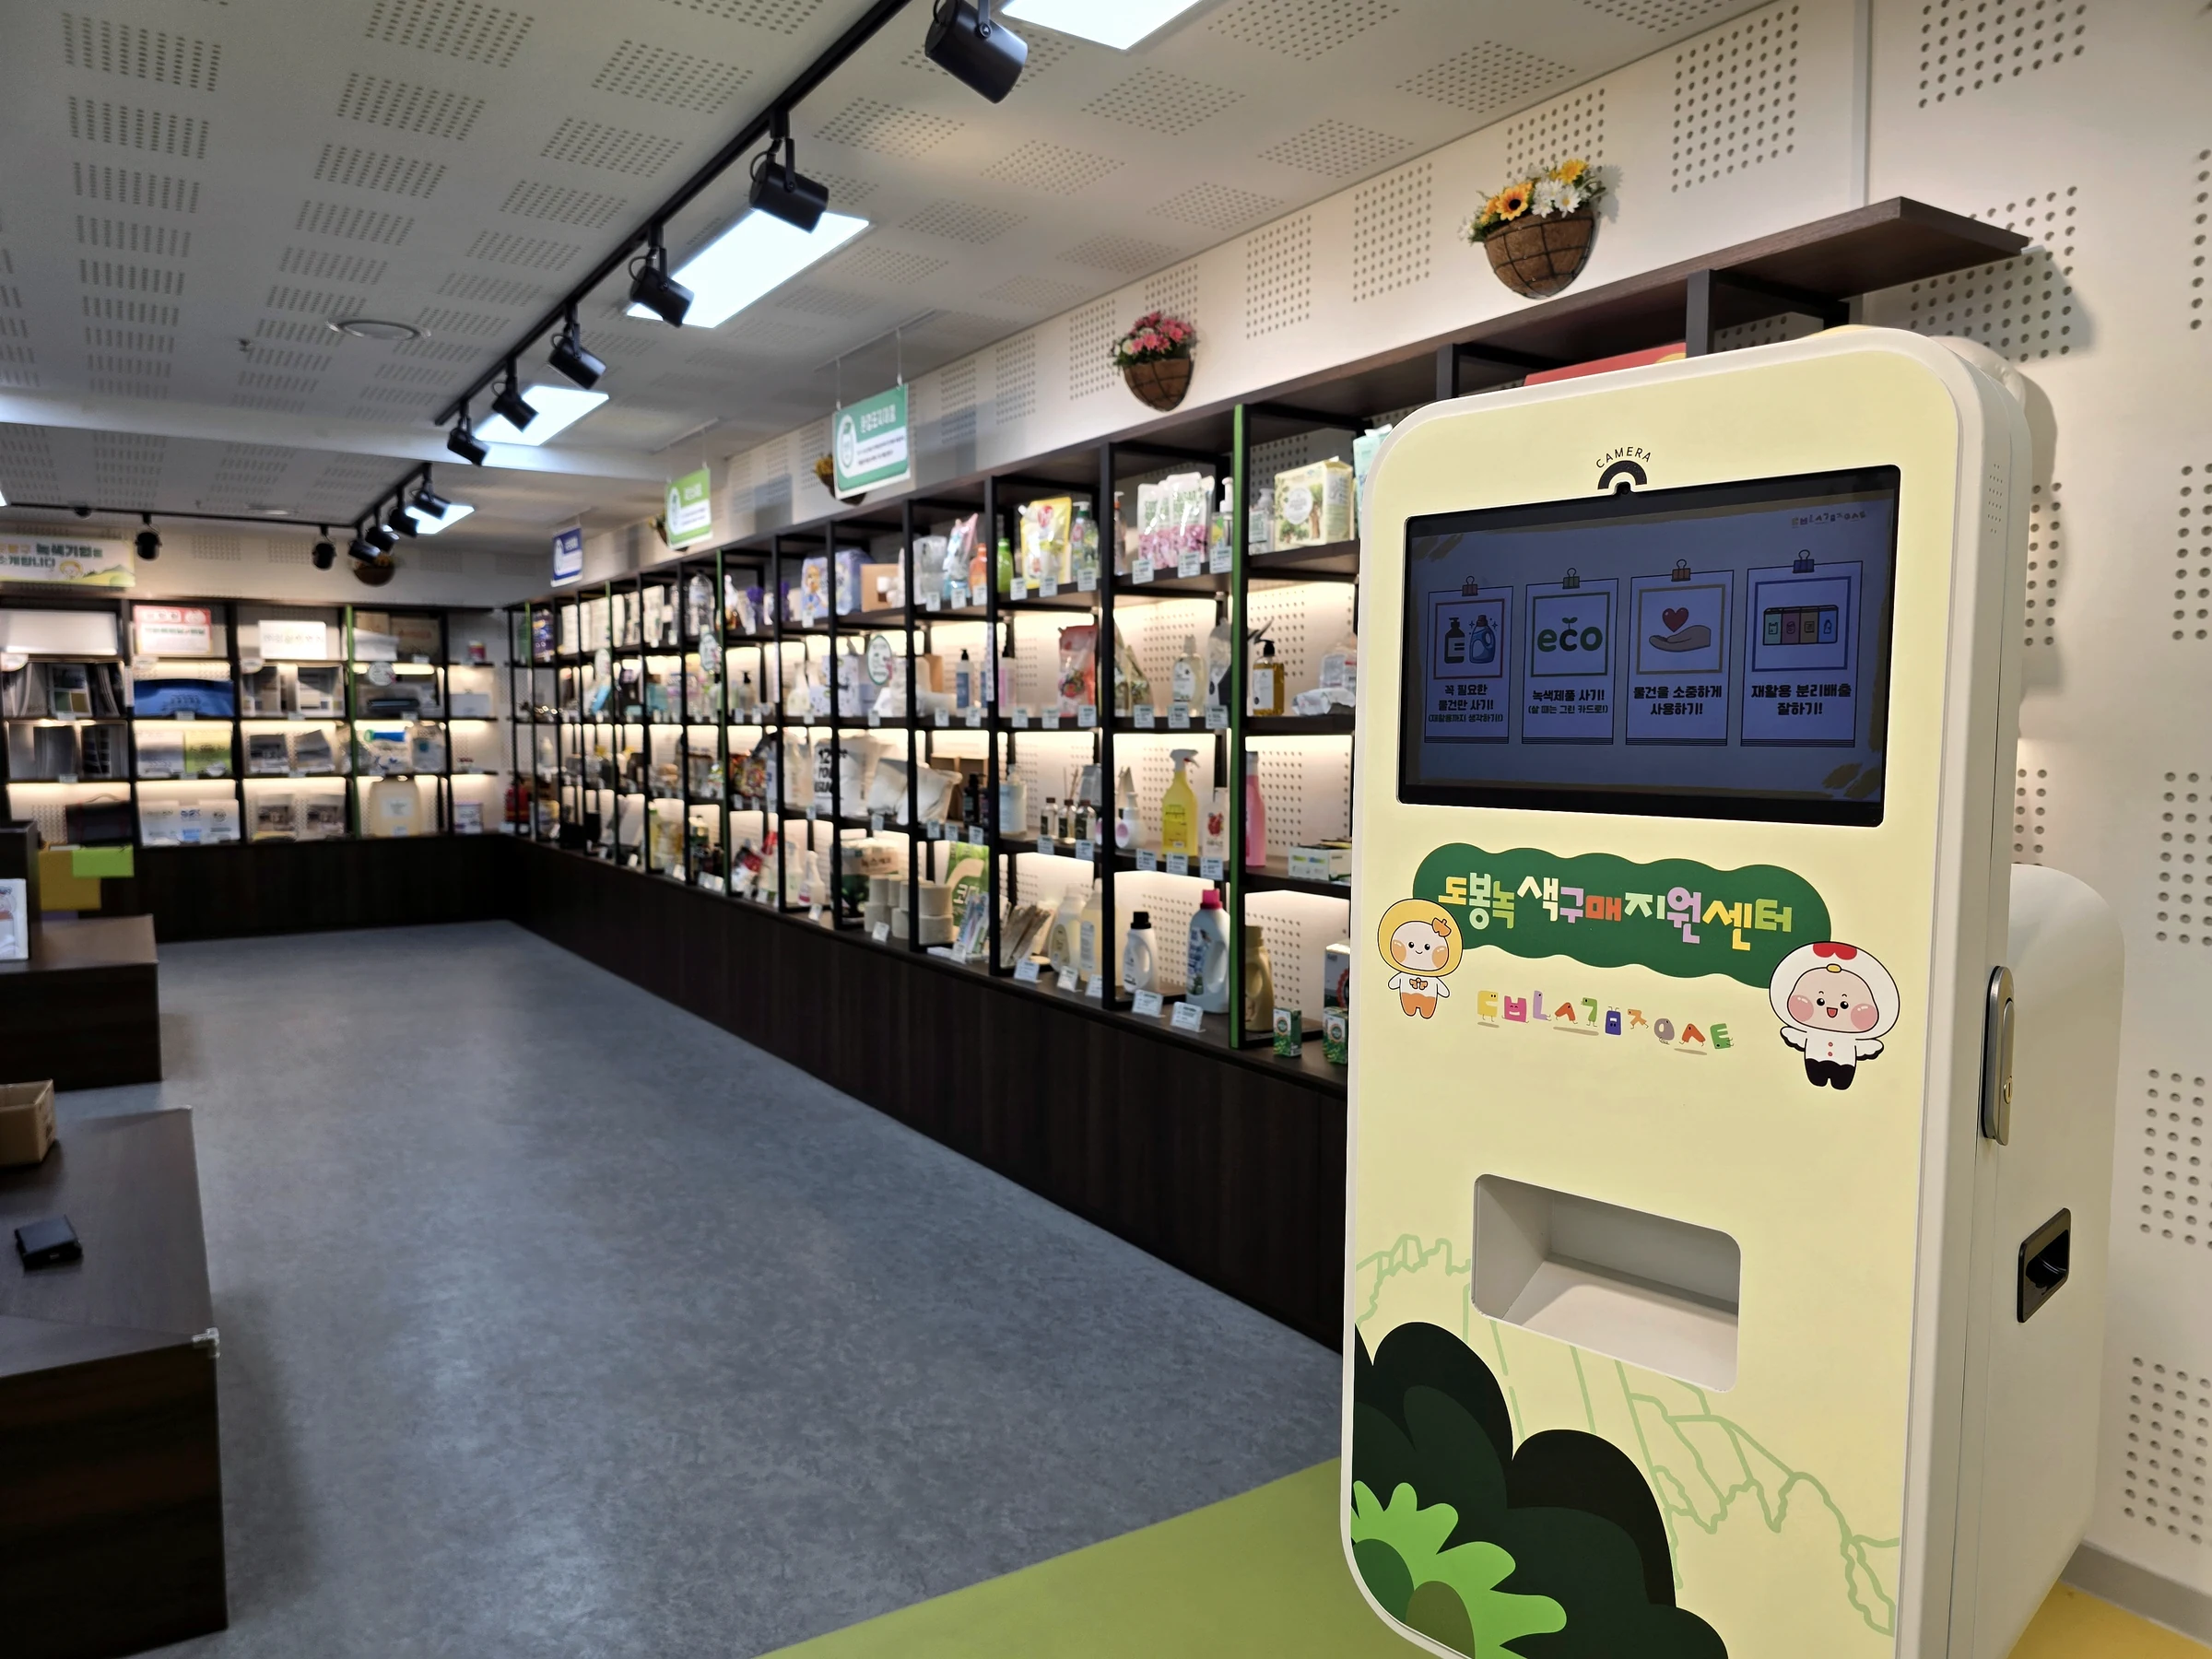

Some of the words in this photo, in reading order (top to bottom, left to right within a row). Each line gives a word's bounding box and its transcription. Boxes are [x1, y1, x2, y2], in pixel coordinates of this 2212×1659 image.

[1595, 446, 1651, 468] CAMERA
[1537, 627, 1603, 653] eco
[1445, 685, 1454, 695] 꼭
[1458, 684, 1488, 695] 필요한
[1532, 689, 1575, 701] 녹색제품
[1579, 689, 1605, 701] 사기!
[1633, 686, 1669, 700] 물건을
[1672, 685, 1722, 699] 소중하게
[1751, 684, 1792, 698] 재활용
[1795, 683, 1852, 698] 분리배출
[1439, 700, 1467, 711] 물건만
[1470, 700, 1494, 711] 사기!
[1541, 705, 1557, 714] 때는
[1559, 705, 1575, 714] 그린
[1650, 702, 1703, 715] 사용하기!
[1777, 701, 1823, 715] 잘하기!
[1438, 872, 1793, 951] 도봉녹색구매지원센터
